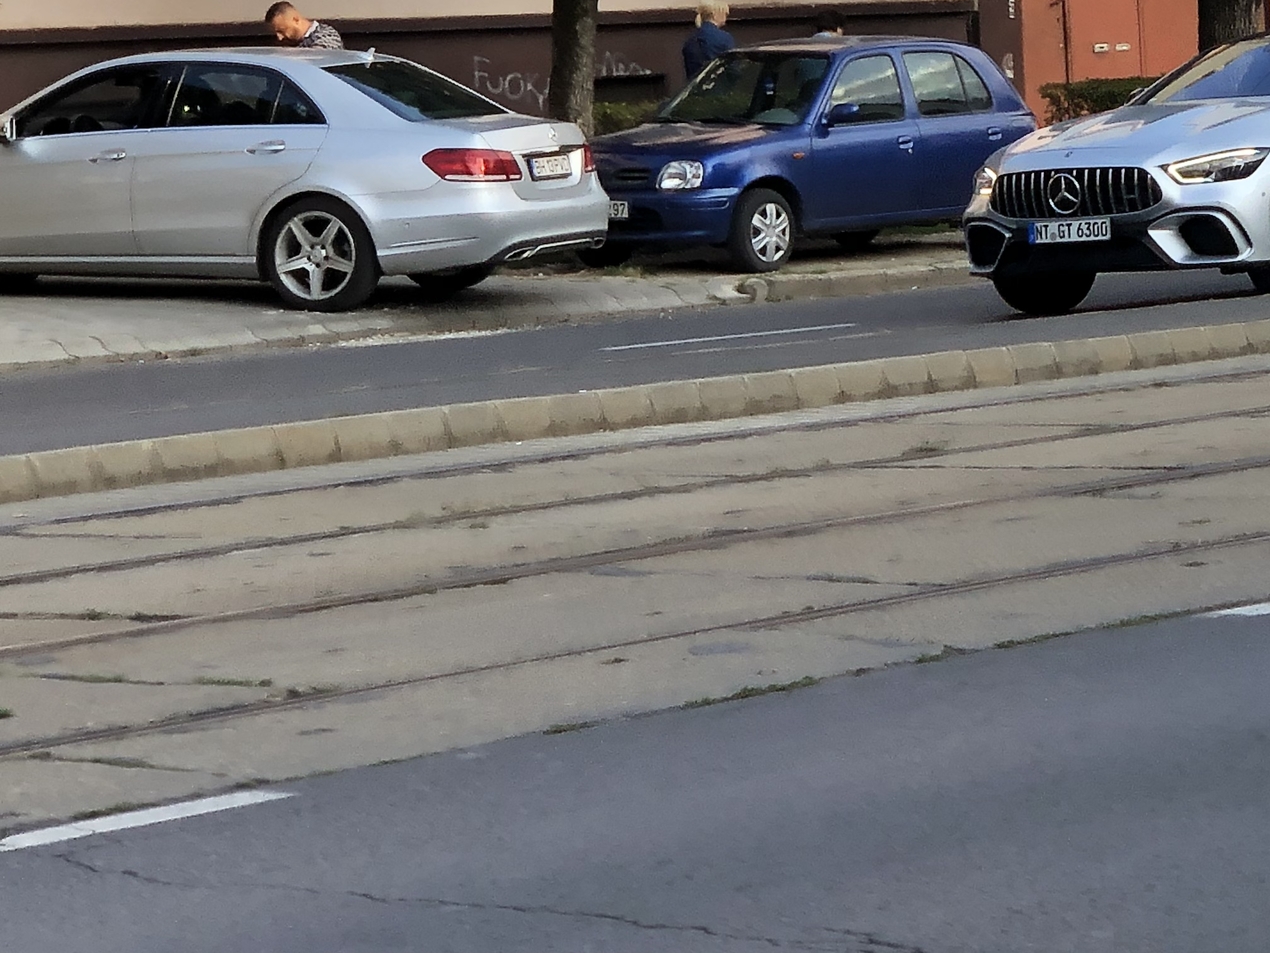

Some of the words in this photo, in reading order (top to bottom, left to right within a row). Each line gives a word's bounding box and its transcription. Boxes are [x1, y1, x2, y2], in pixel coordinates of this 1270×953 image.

[1035, 224, 1050, 240] NT
[1057, 222, 1073, 239] GT
[1076, 221, 1108, 238] 6300
